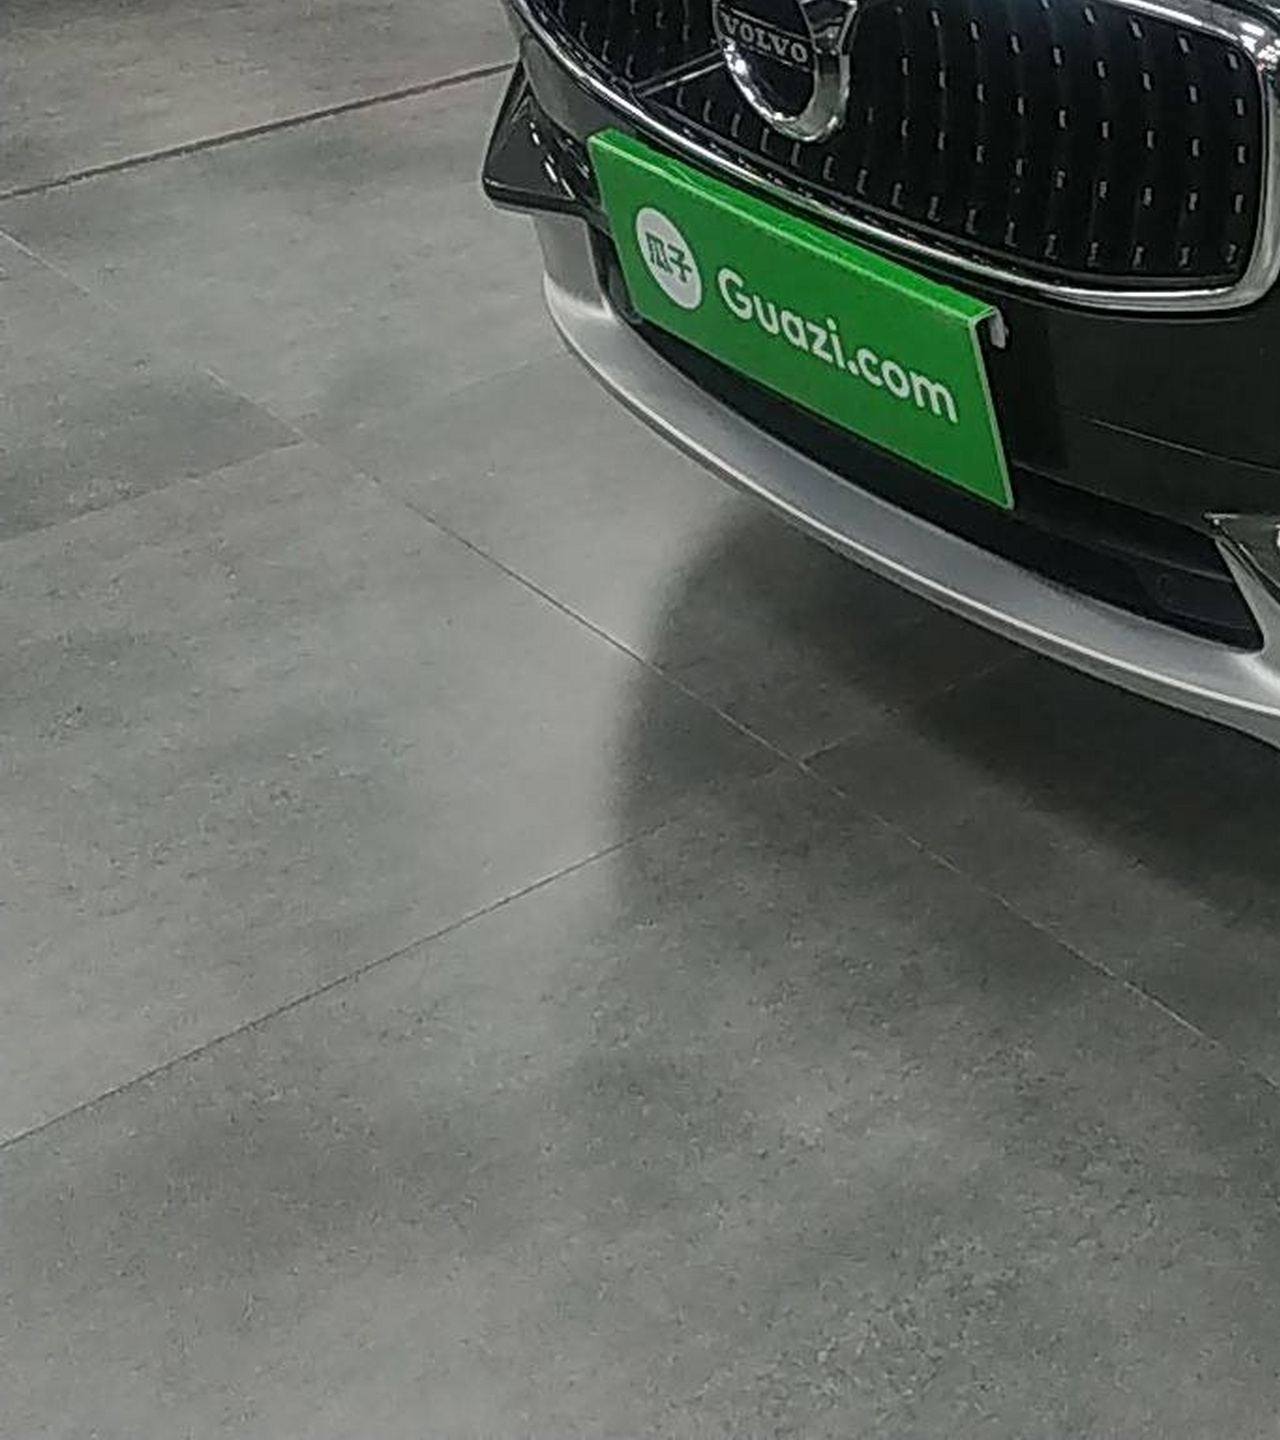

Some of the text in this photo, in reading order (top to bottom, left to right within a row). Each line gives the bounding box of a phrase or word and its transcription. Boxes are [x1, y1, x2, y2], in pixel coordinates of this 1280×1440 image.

[720, 11, 808, 63] VOLVO
[645, 231, 692, 284] 瓜子
[716, 267, 958, 425] Guazi.com
